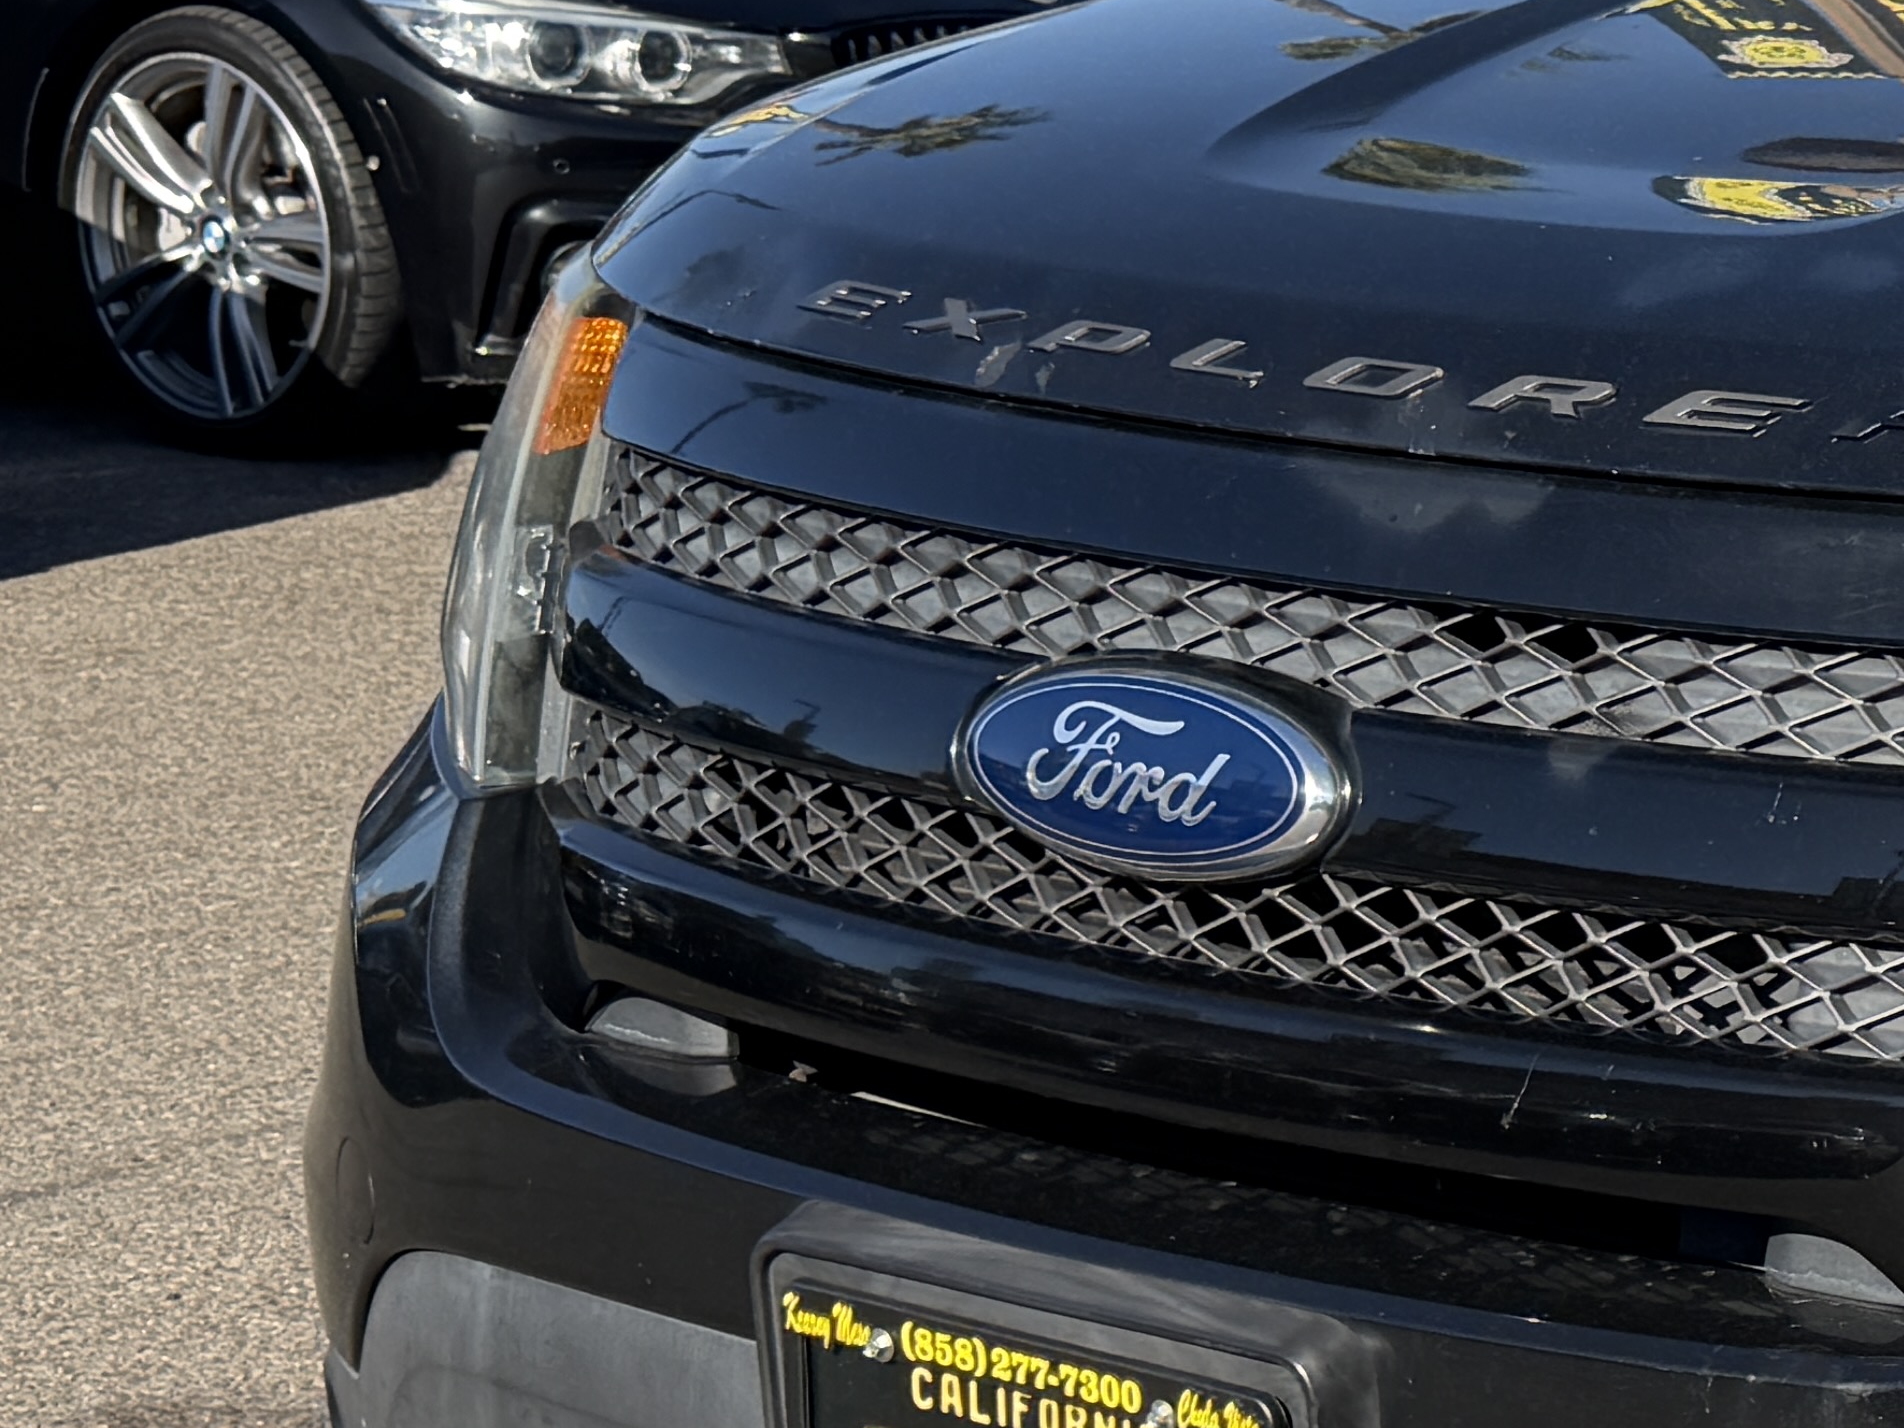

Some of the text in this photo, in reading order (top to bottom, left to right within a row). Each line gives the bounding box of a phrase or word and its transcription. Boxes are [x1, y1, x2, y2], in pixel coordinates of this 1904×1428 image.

[1026, 699, 1230, 826] Ford
[900, 1320, 1142, 1414] (858) 277-7300
